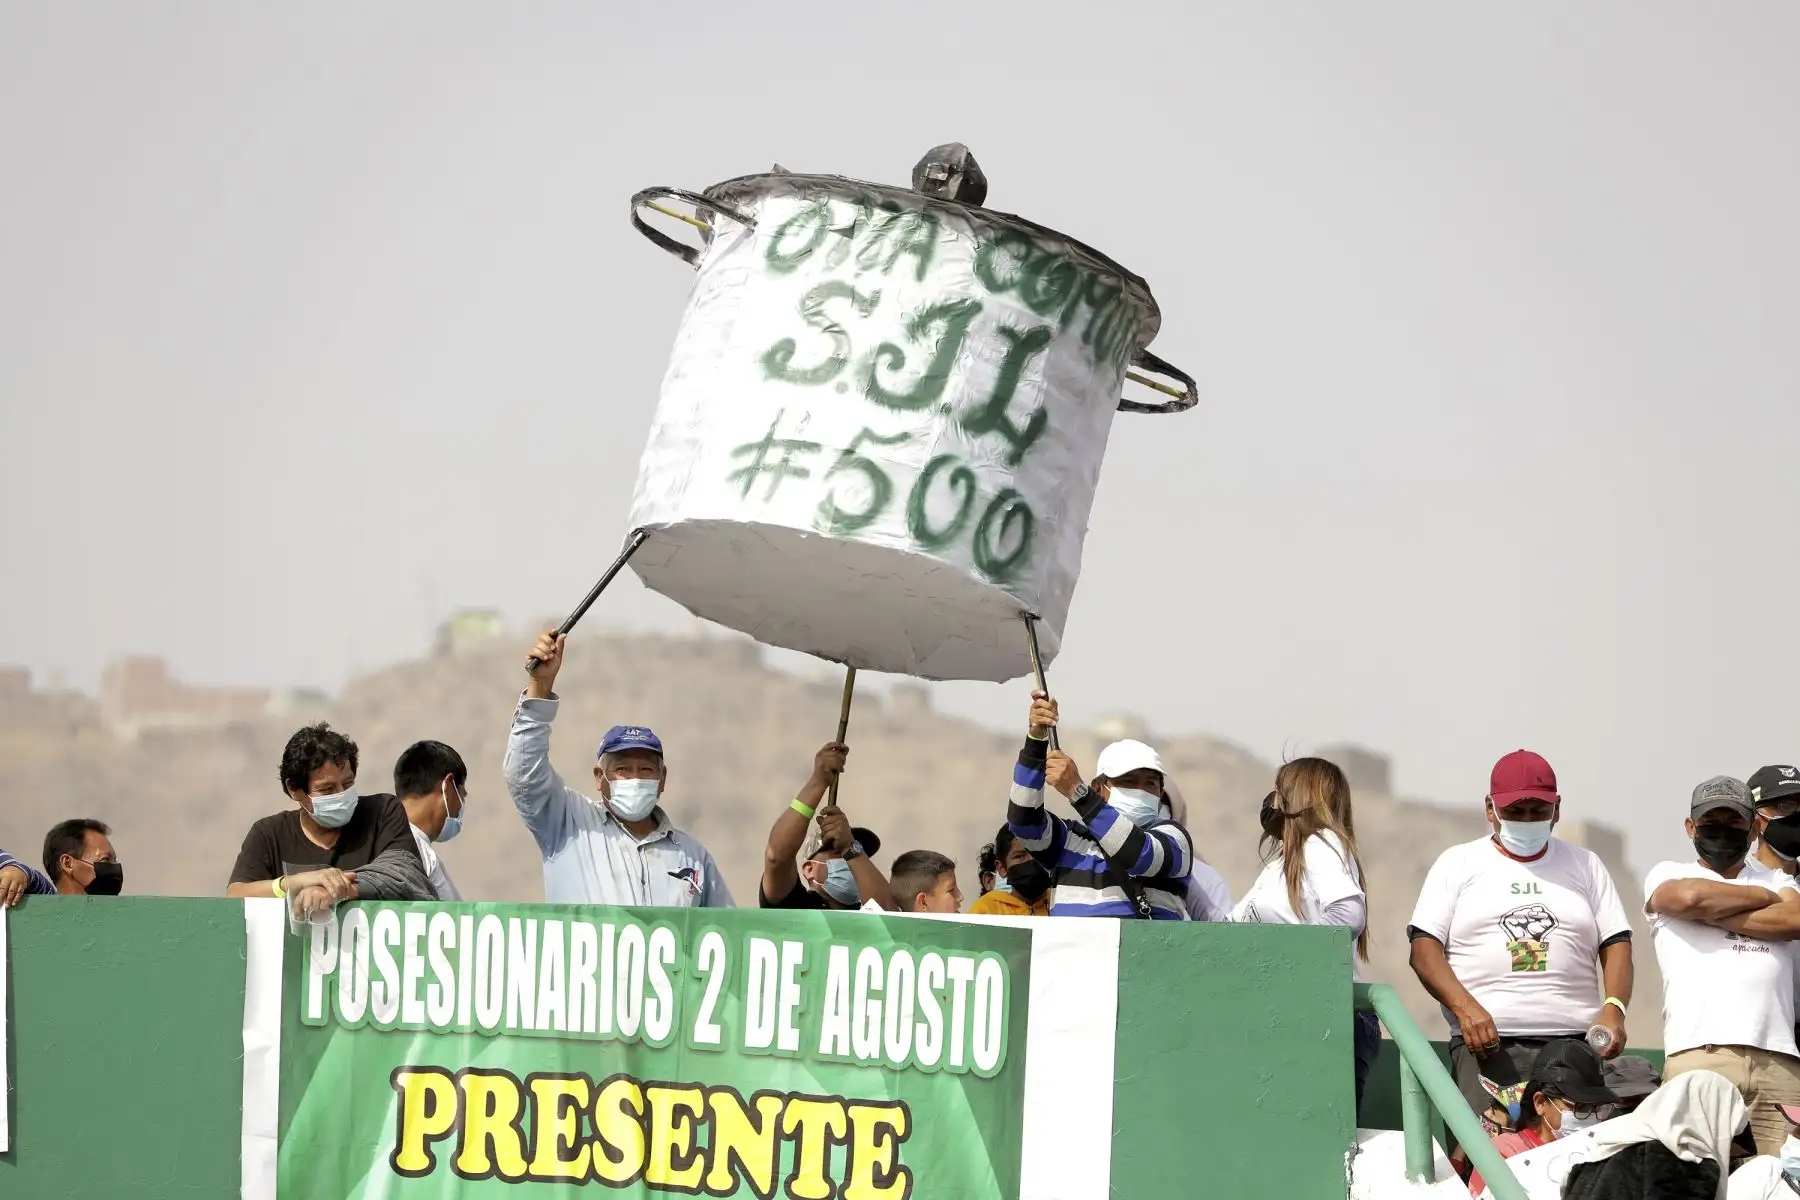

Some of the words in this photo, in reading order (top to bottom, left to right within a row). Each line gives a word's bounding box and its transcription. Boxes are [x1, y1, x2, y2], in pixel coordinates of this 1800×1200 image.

[726, 407, 1036, 582] #500
[1510, 882, 1543, 895] SJL
[307, 907, 676, 1042] POSESIONARIOS
[693, 931, 727, 1045] 2
[744, 937, 804, 1052] DE
[818, 945, 1004, 1071] AGOSTO
[391, 1068, 911, 1200] PRESENTE
